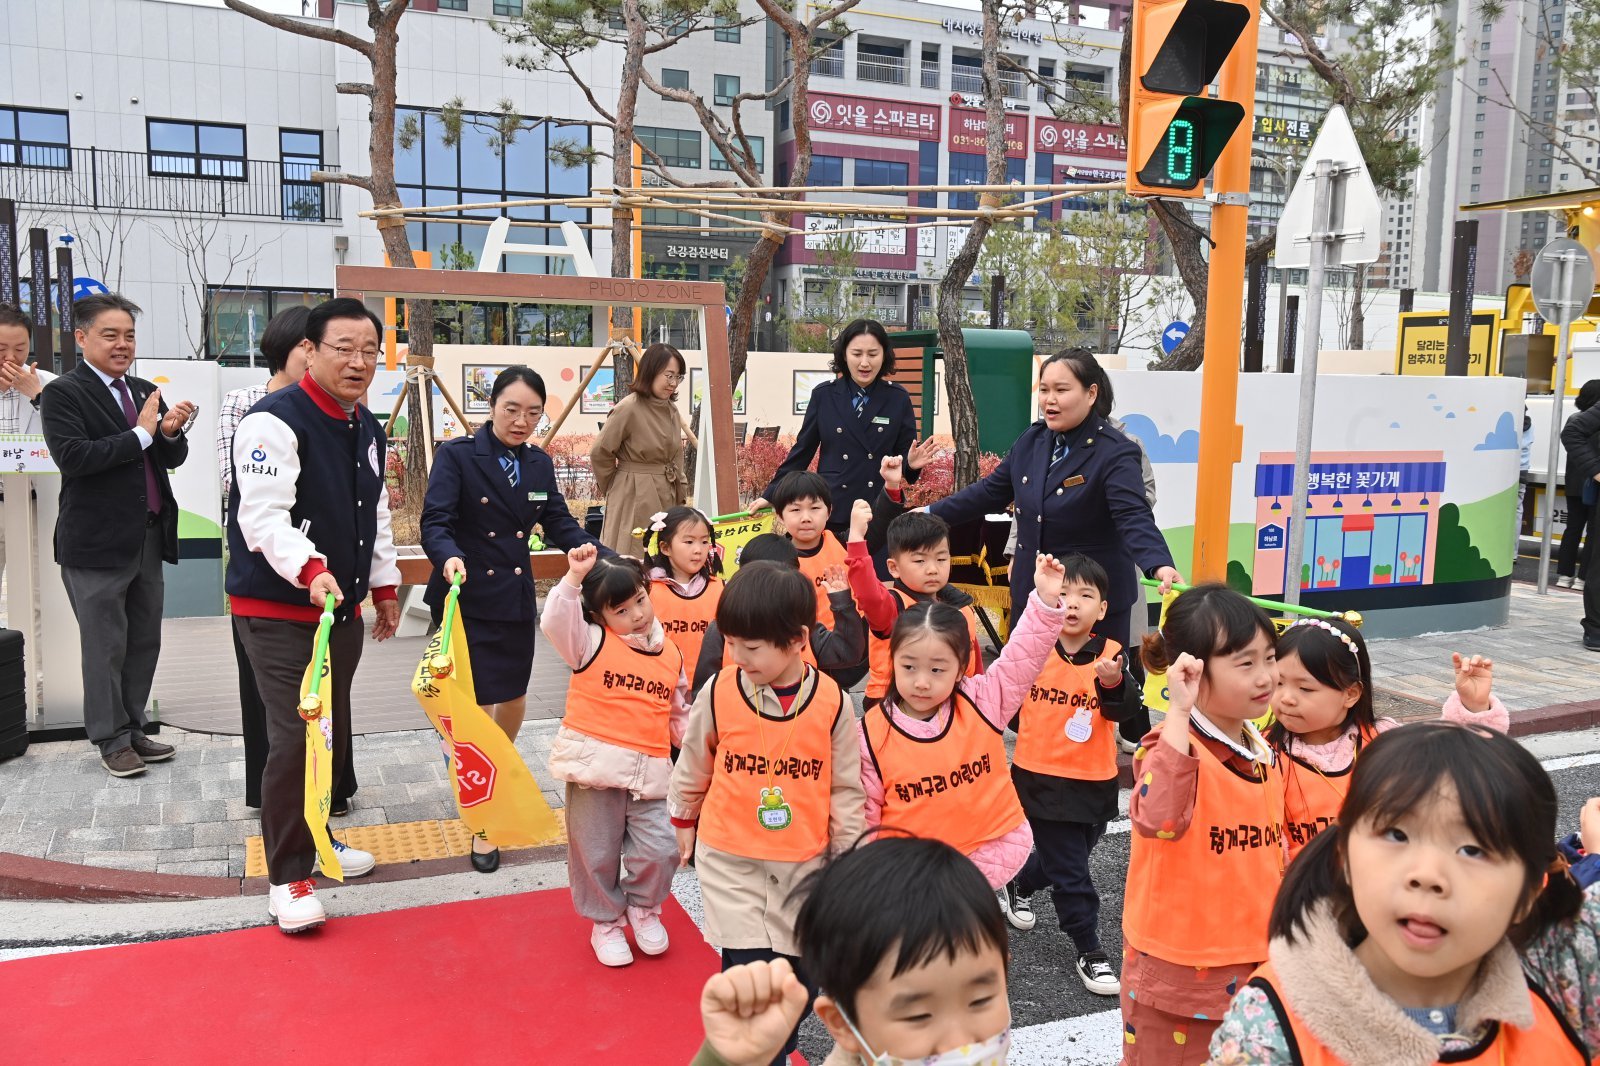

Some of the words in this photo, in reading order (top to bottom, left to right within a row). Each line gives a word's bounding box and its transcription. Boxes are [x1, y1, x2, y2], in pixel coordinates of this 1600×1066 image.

[837, 104, 868, 127] 잇올
[874, 108, 935, 130] 스파르타
[1062, 128, 1089, 149] 잇올
[1168, 120, 1193, 180] 8
[667, 245, 728, 260] 건강검진센터
[590, 281, 650, 298] PHOTO
[656, 284, 703, 300] ZONE
[1416, 340, 1445, 351] 달리는
[3, 448, 24, 460] 하남
[242, 463, 277, 477] 하남시
[1307, 471, 1352, 490] 행복한
[1356, 471, 1400, 488] 꽃가게
[603, 670, 645, 691] 청개구리
[1030, 685, 1069, 705] 청개구리
[725, 750, 770, 776] 청개구리
[774, 757, 823, 780] 어린이집
[895, 774, 948, 803] 청개구리
[949, 752, 991, 788] 어린이집
[1210, 824, 1262, 855] 청개구리
